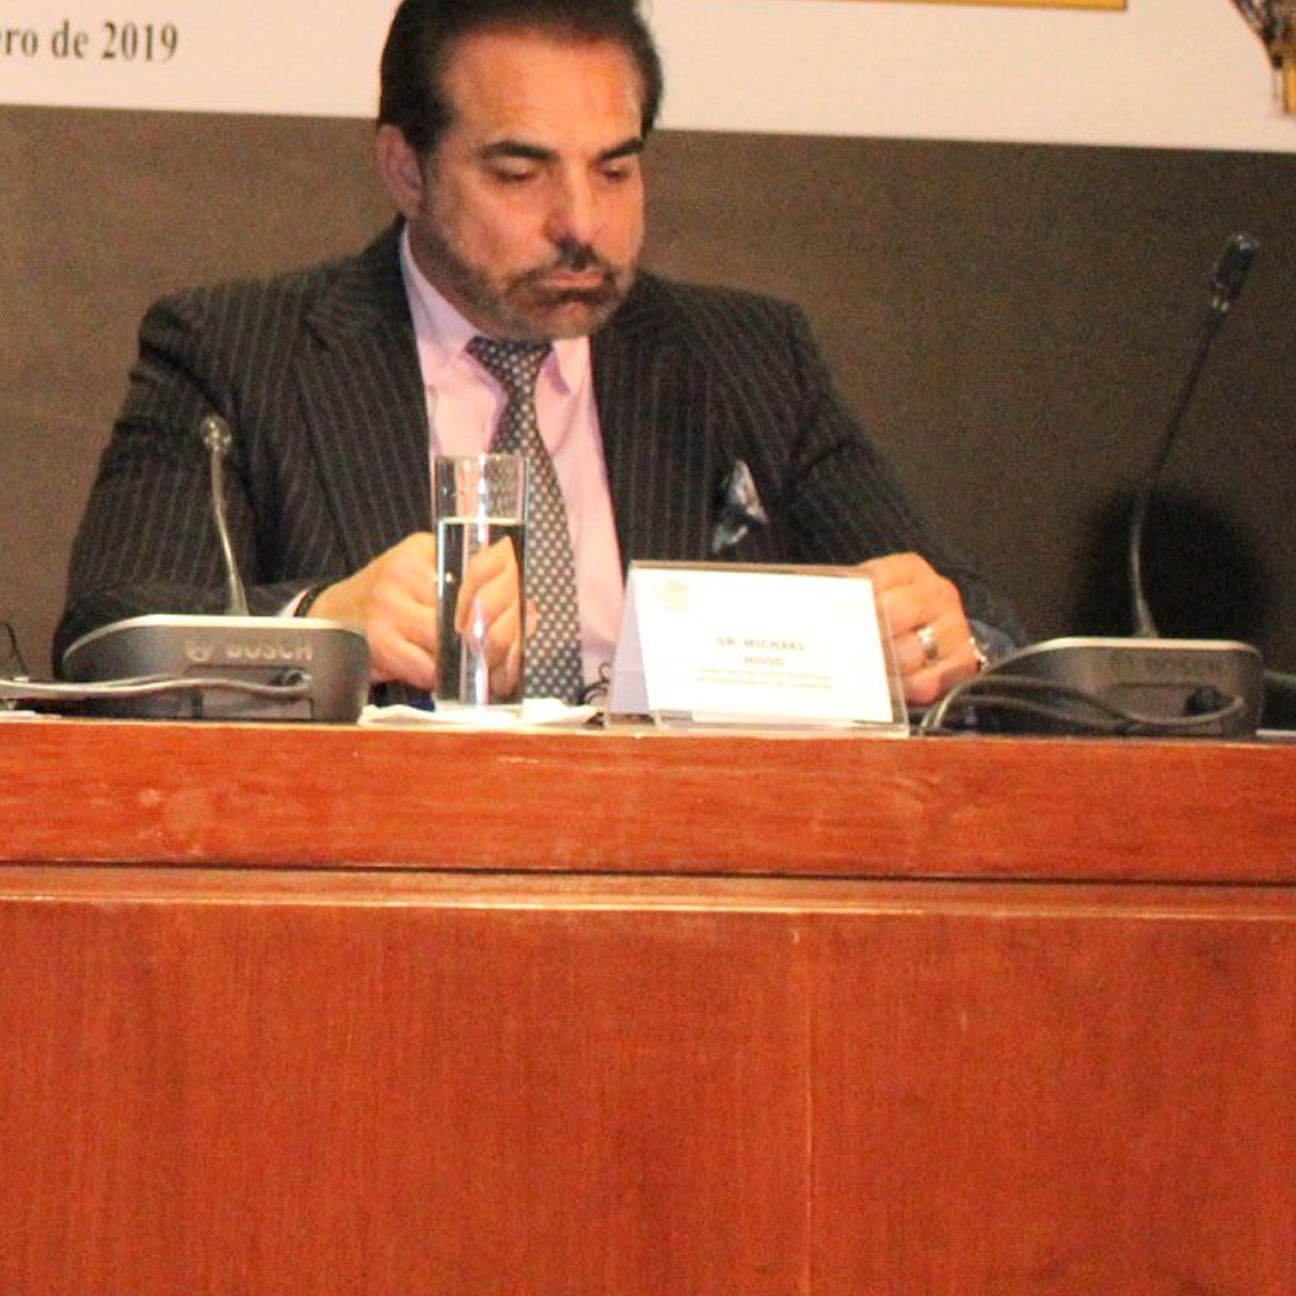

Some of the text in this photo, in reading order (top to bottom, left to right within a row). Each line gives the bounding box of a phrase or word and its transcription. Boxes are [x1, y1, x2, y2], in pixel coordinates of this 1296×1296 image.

[50, 19, 89, 60] de
[101, 20, 179, 62] 2019
[225, 639, 313, 661] BOSCH
